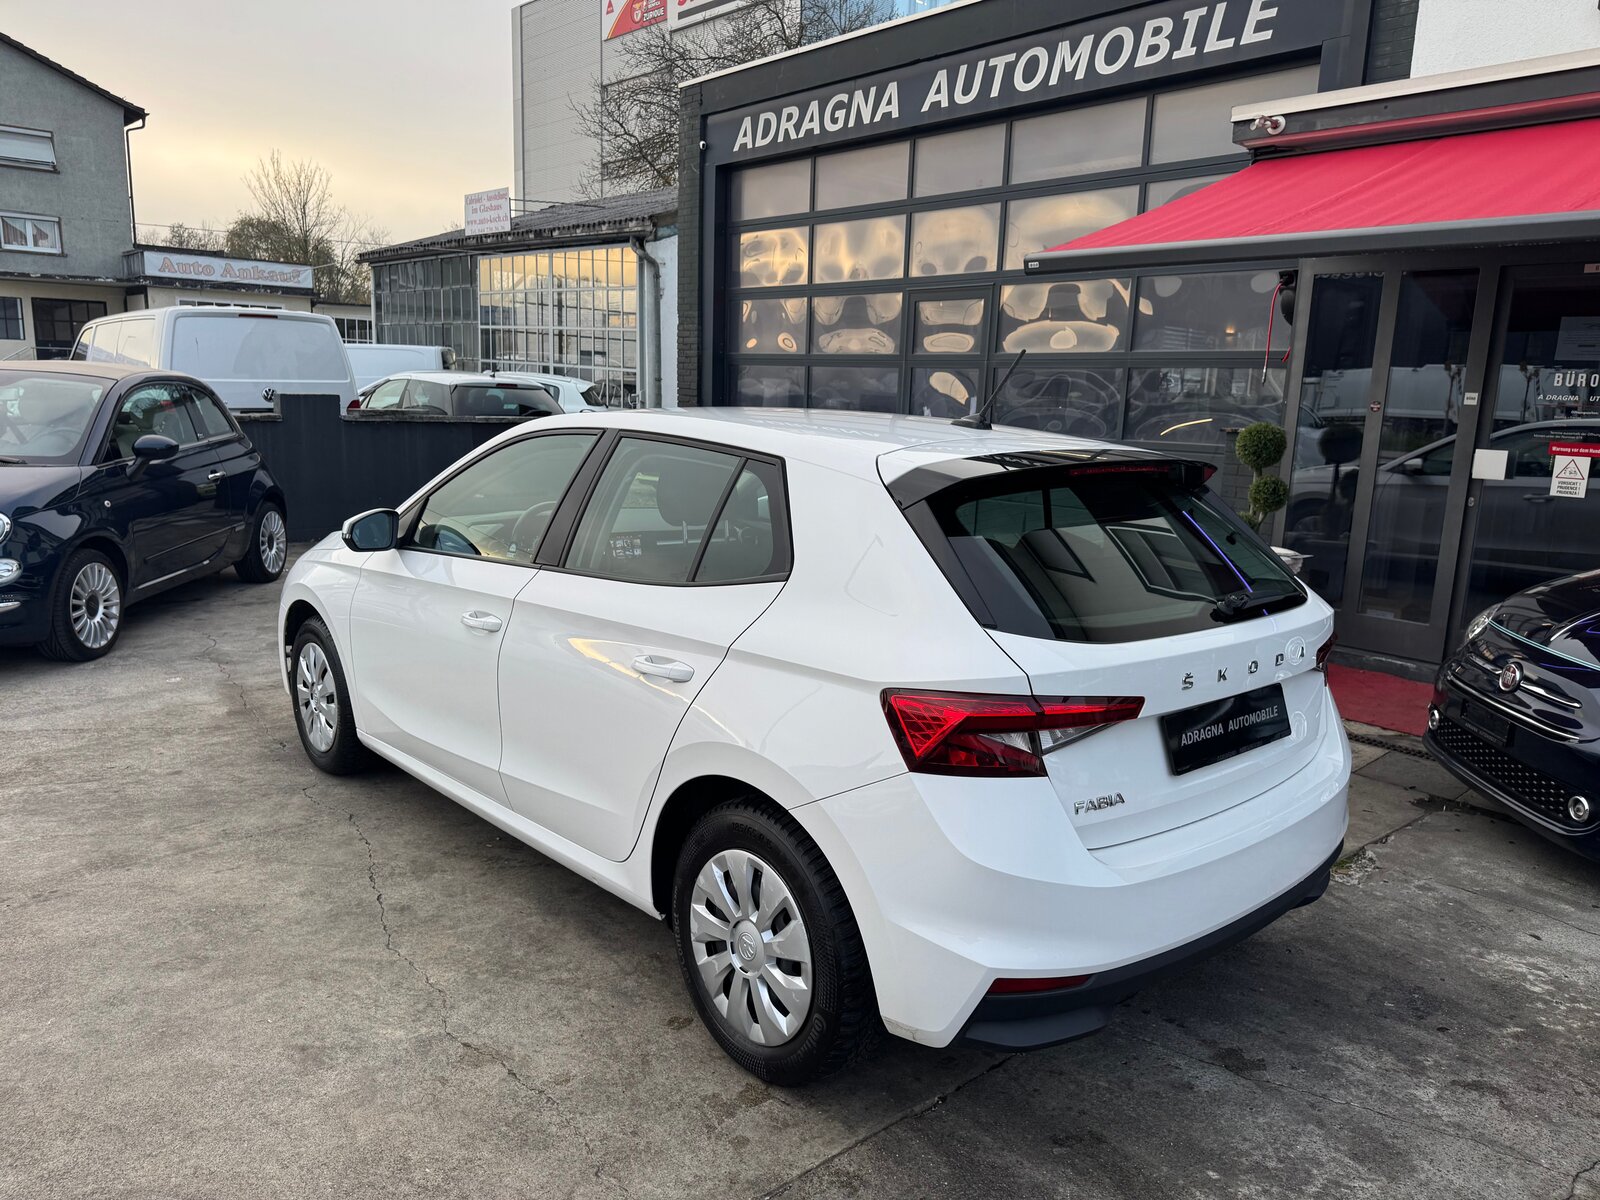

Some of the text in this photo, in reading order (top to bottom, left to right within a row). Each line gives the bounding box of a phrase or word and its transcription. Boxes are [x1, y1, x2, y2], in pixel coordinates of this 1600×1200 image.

[733, 0, 1279, 152] ADRAGNA AUTOMOBILE
[159, 257, 300, 283] Auto Ankauf
[1553, 371, 1600, 387] BÜRO
[1181, 646, 1305, 690] ŠKODA
[1180, 705, 1278, 746] ADRAGNA AUTOMOBILE
[1073, 792, 1125, 815] FABIA
